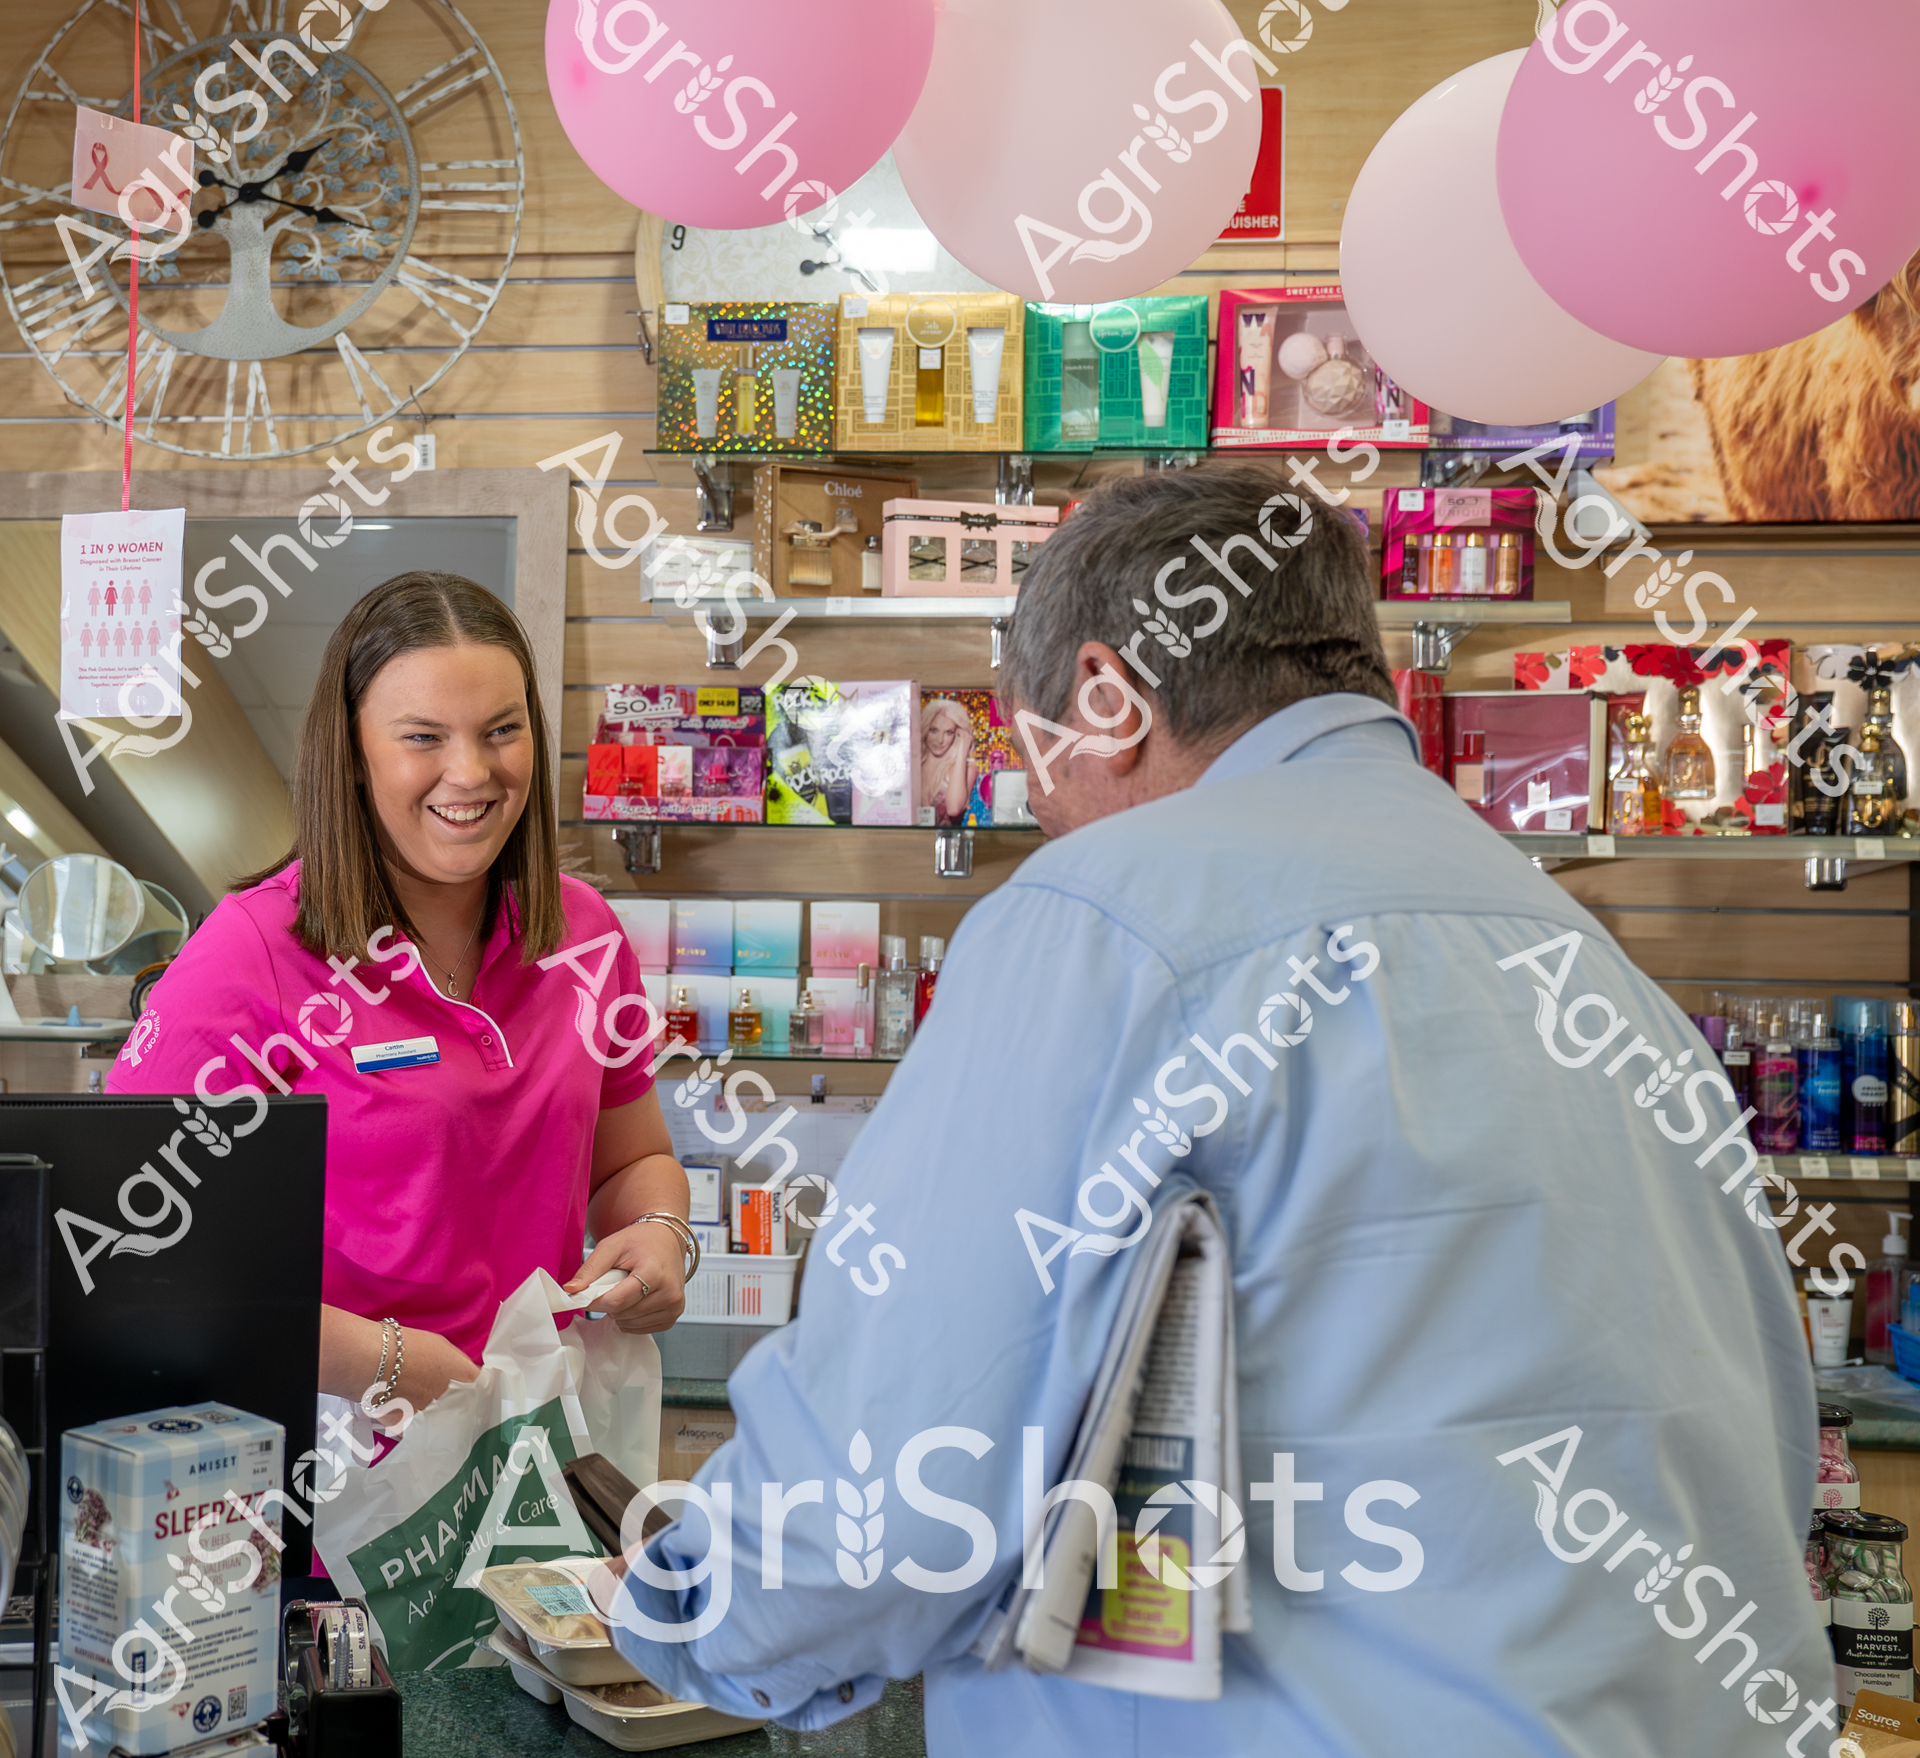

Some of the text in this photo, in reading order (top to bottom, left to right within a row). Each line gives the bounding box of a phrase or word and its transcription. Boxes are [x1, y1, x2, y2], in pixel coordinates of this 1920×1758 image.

[671, 225, 686, 251] 9
[824, 481, 863, 498] Chloé
[80, 542, 163, 555] 1 IN 9 WOMEN
[80, 558, 109, 566] Diagnosed
[143, 1015, 160, 1054] SUPPORT
[772, 1191, 782, 1224] touch
[189, 1456, 237, 1475] AMISET
[154, 1490, 267, 1540] SLEEPZZZ
[379, 1427, 551, 1590] PHARMACY
[517, 1493, 560, 1524] Care
[1856, 1633, 1898, 1643] RANDOM
[1854, 1671, 1886, 1679] Chocolate
[1863, 1679, 1892, 1687] Humbugs
[1857, 1709, 1901, 1728] Source
